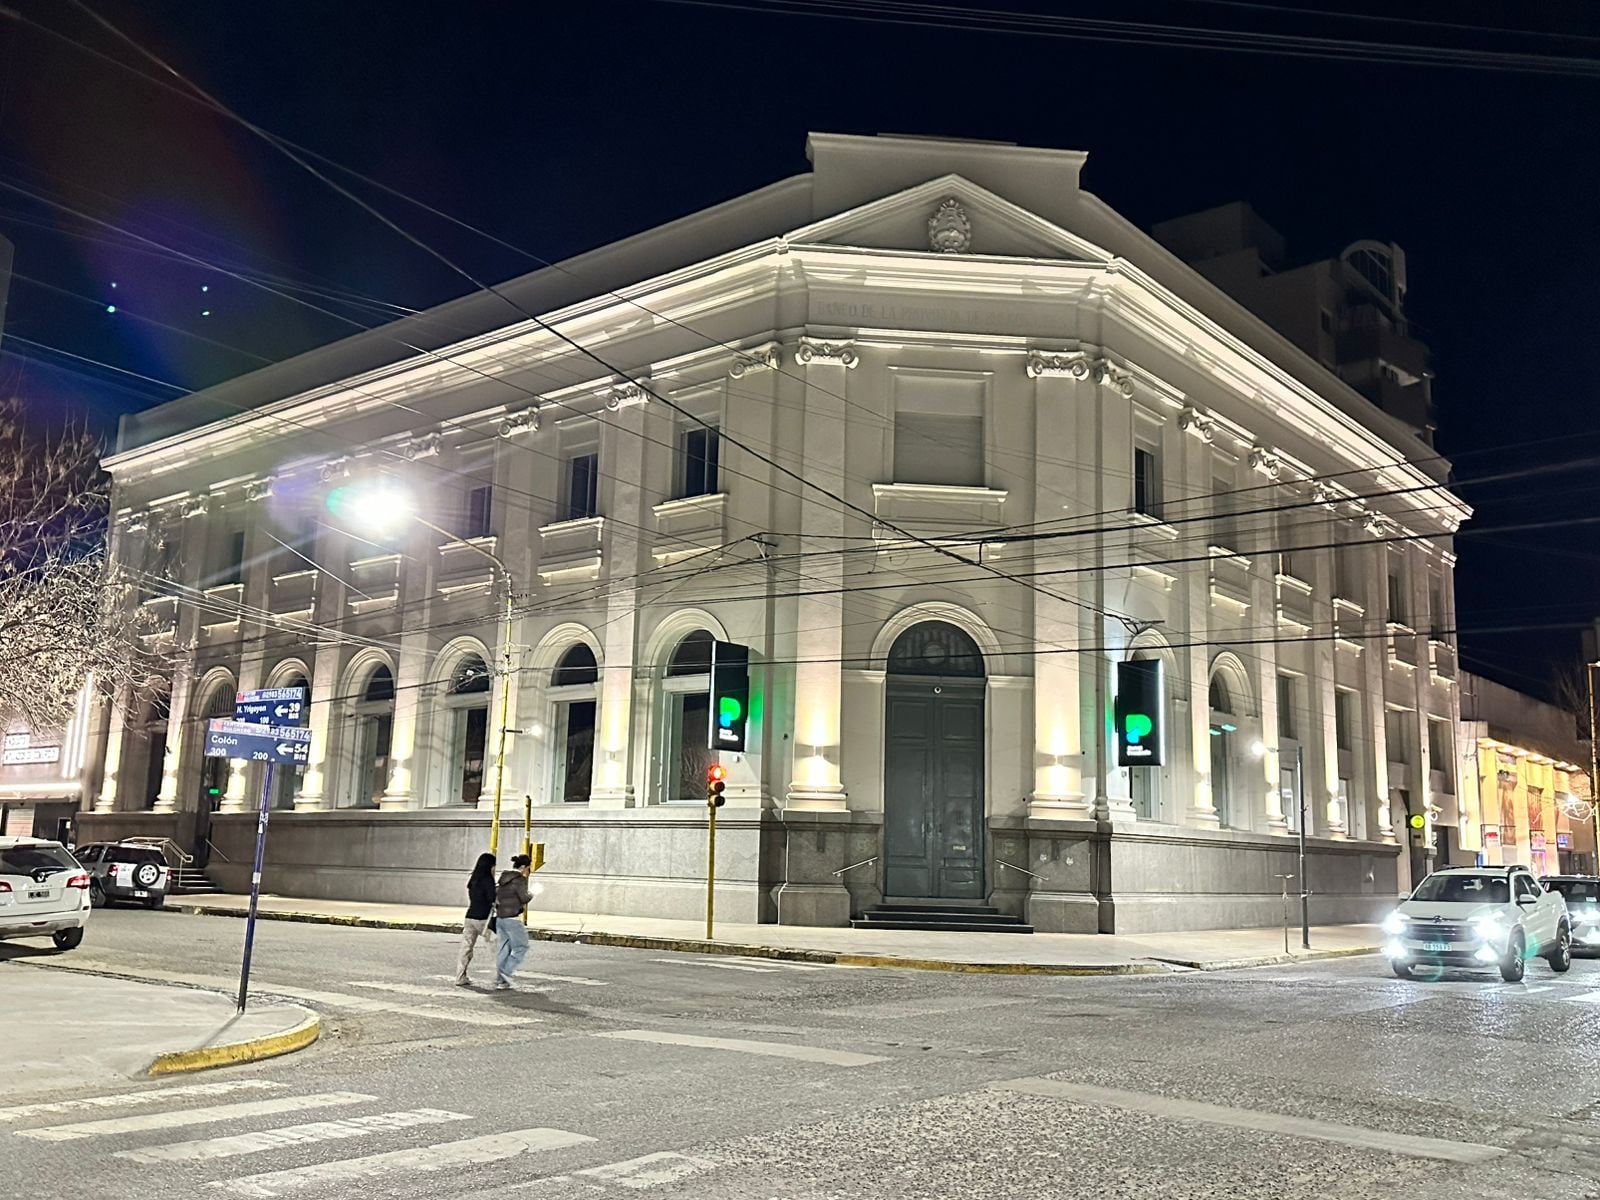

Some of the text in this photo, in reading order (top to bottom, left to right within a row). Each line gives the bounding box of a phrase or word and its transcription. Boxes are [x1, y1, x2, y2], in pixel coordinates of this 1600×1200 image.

[289, 702, 300, 712] 39
[211, 735, 308, 753] Colón 54
[253, 752, 269, 760] 200
